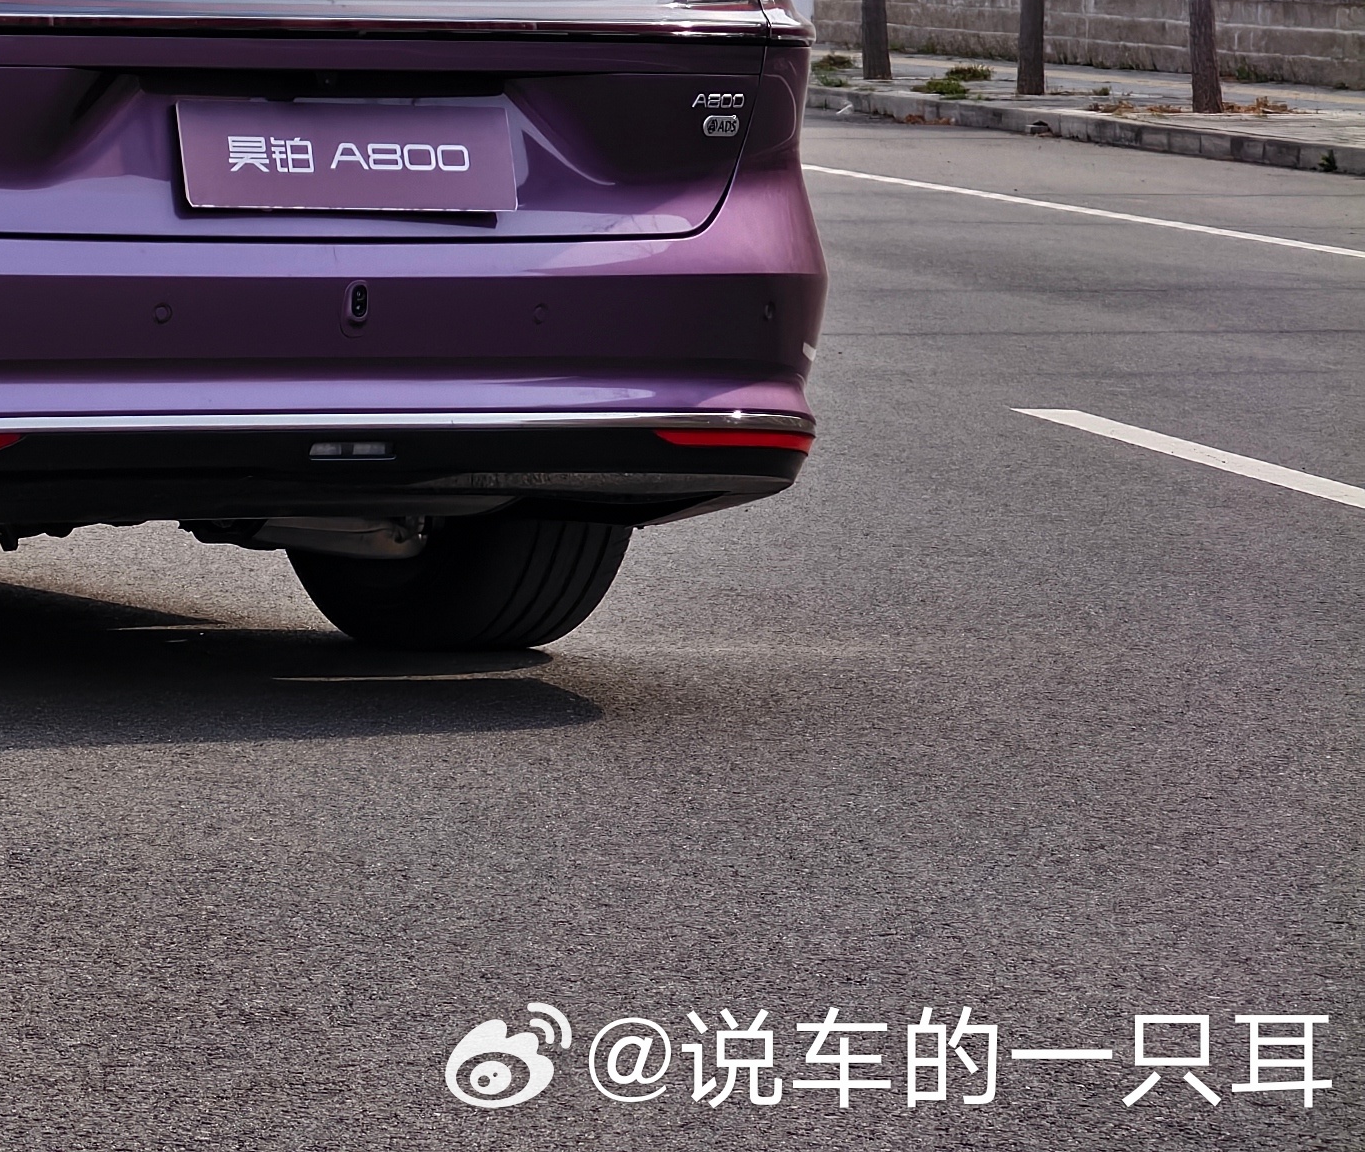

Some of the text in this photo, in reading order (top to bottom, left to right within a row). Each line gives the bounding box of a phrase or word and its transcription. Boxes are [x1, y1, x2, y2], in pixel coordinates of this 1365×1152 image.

[692, 94, 744, 108] A800
[228, 136, 469, 172] 昊铂 A800
